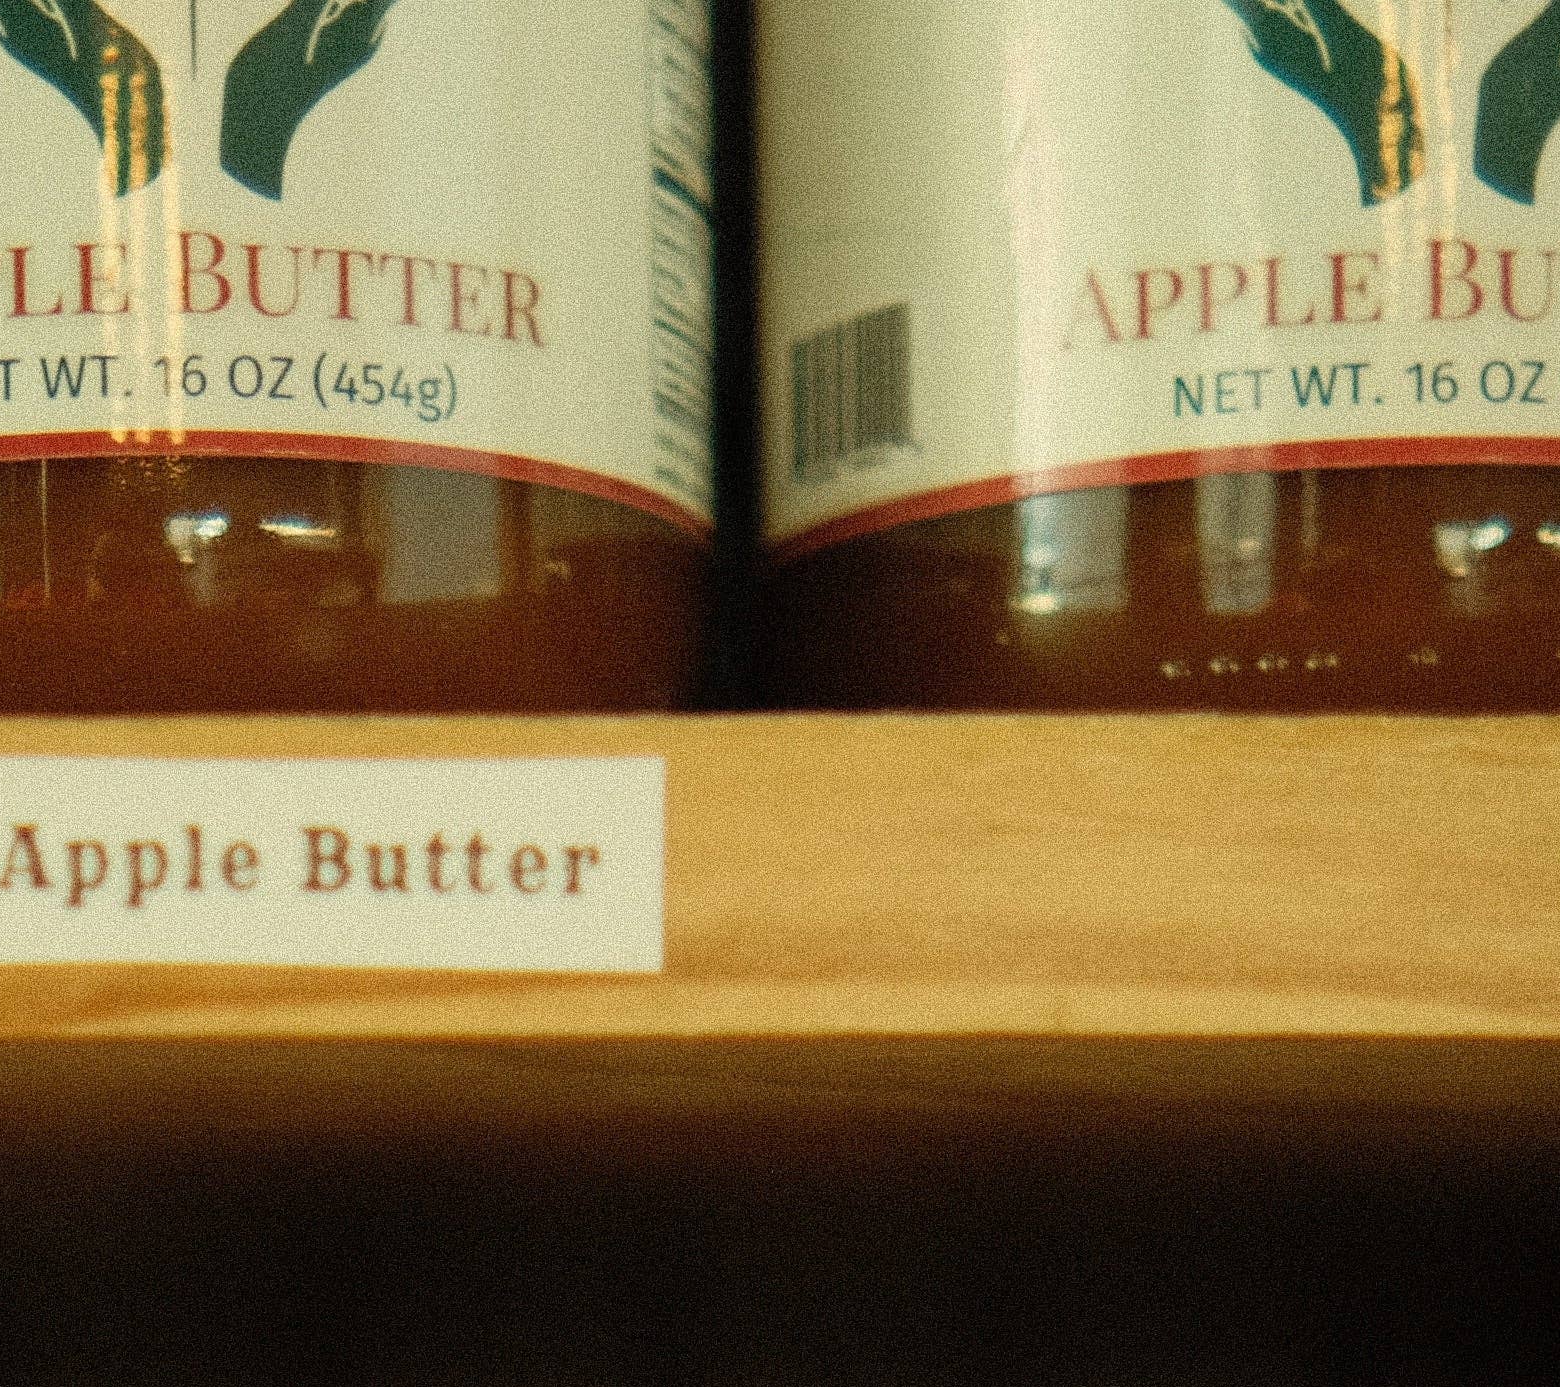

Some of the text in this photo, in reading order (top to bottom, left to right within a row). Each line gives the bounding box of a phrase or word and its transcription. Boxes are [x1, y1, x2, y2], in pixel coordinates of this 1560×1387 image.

[175, 232, 547, 347] BUTTER
[1062, 252, 1383, 349] APPLE
[41, 354, 132, 399] WT.
[154, 355, 208, 397] 16
[228, 355, 295, 399] OZ
[312, 351, 458, 421] (454g)
[1173, 368, 1271, 417] NET
[1289, 363, 1383, 408] WT.
[1406, 363, 1459, 403] 16
[1480, 361, 1545, 404] OZ
[0, 824, 601, 908] Apple Butter
